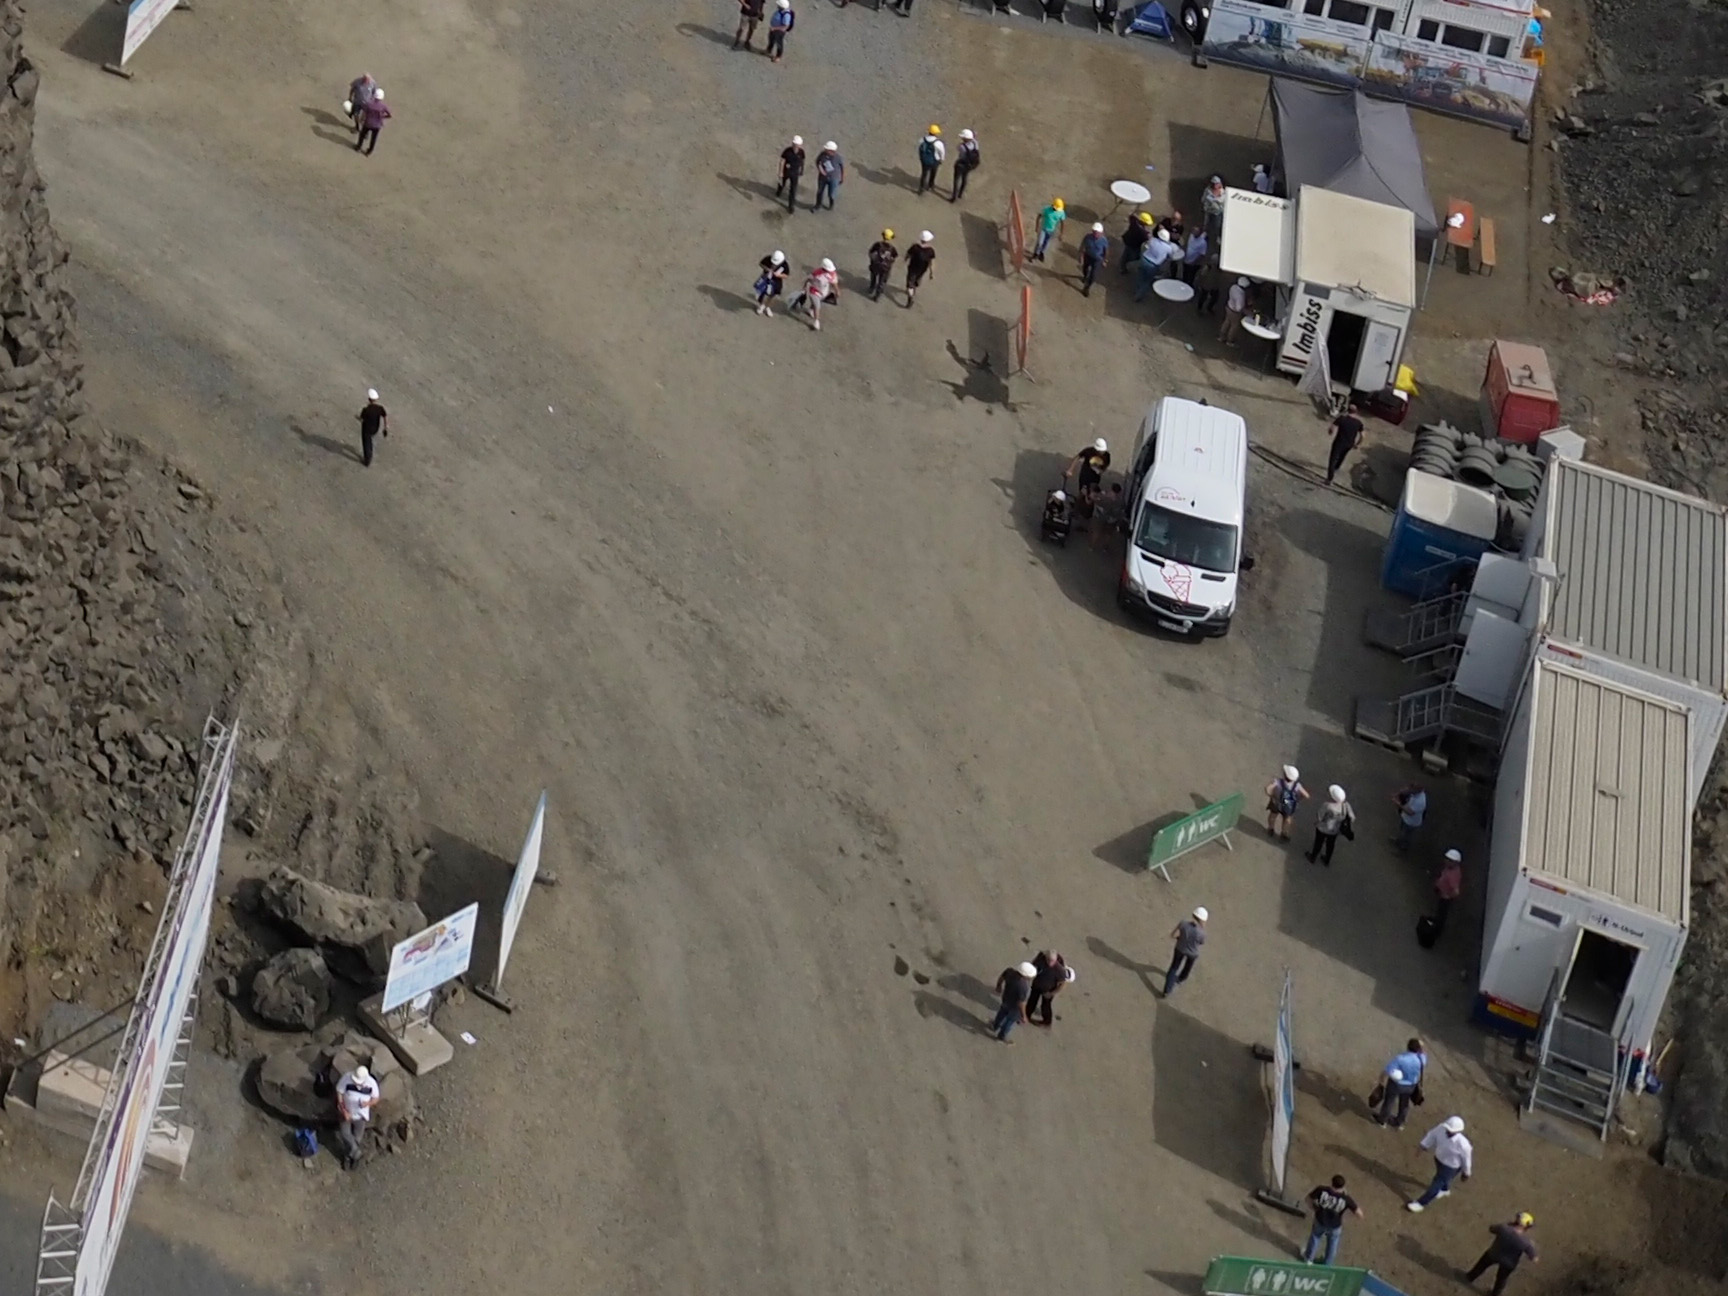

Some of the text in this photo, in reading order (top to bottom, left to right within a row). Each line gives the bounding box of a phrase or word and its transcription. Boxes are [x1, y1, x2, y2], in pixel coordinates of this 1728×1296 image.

[1292, 298, 1323, 355] Imbiss
[1198, 814, 1220, 834] WC
[1294, 1276, 1330, 1292] WC
